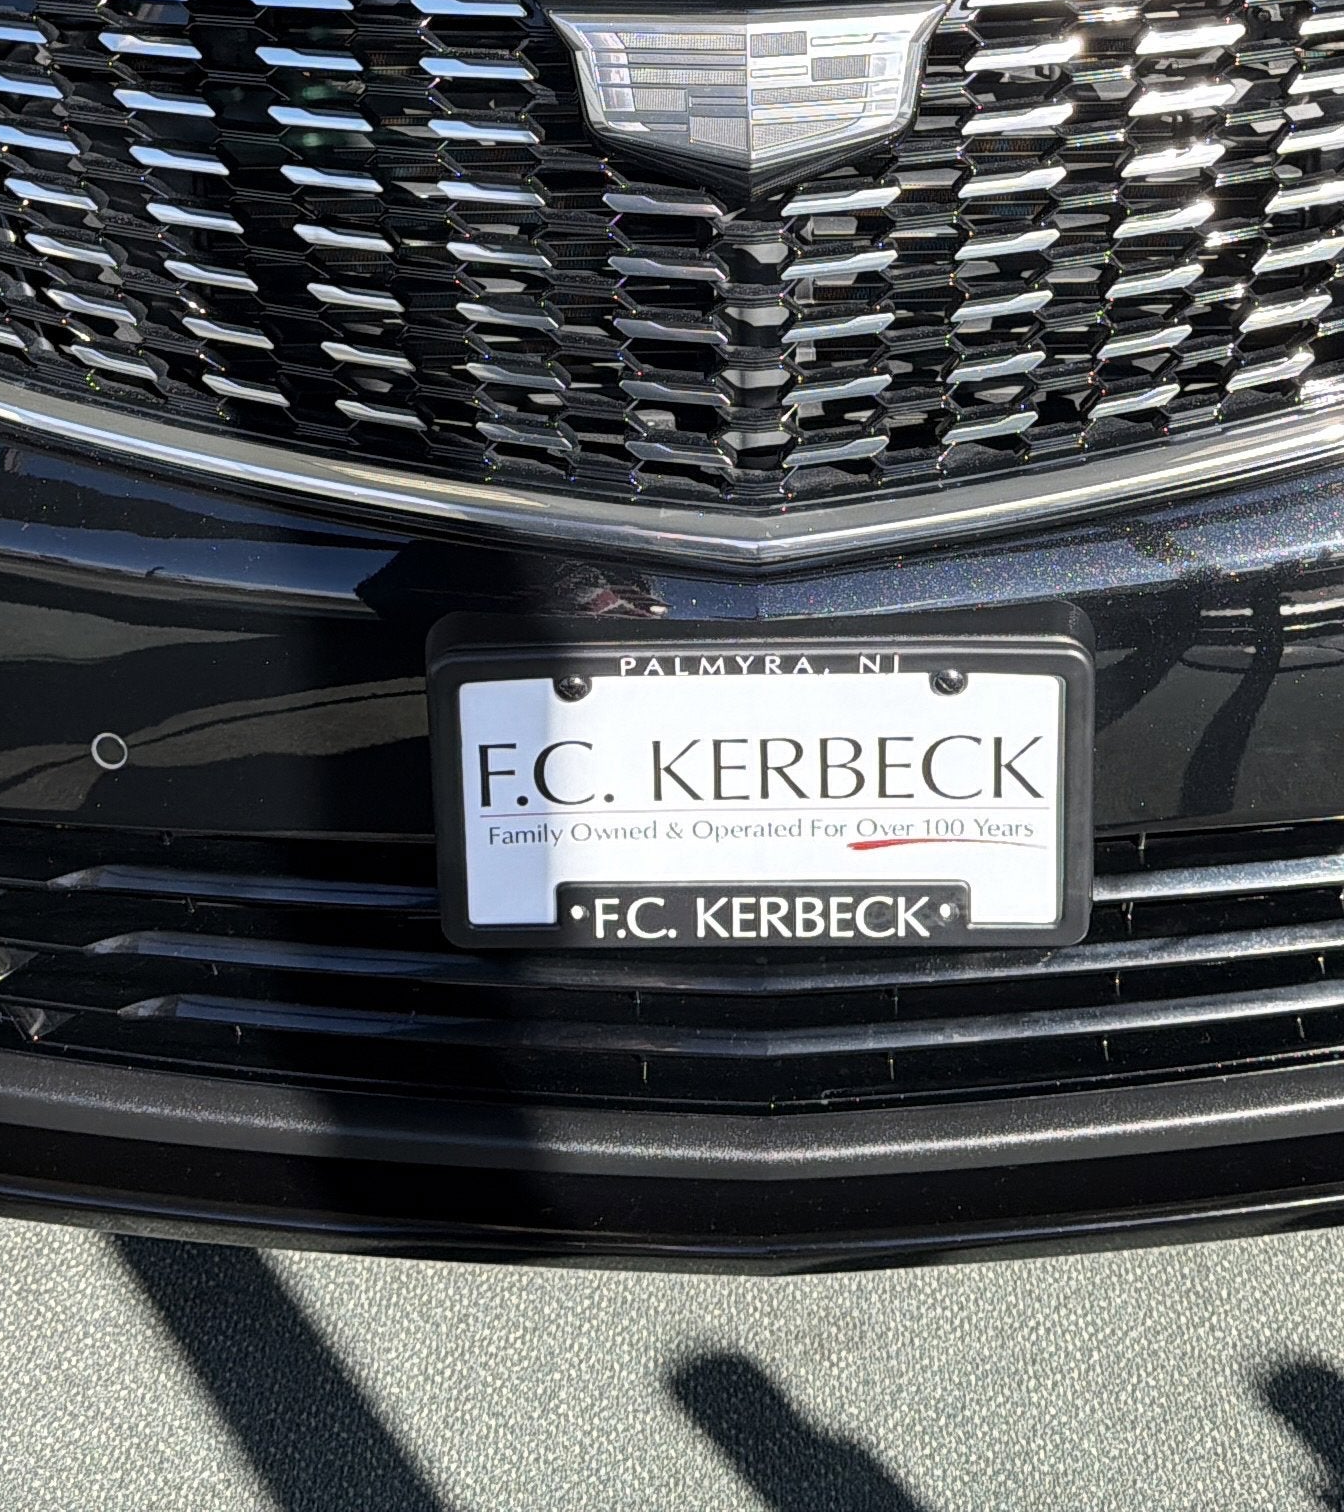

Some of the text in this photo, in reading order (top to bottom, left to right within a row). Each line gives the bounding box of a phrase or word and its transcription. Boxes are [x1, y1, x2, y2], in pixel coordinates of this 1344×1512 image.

[619, 654, 831, 676] PALMYRA,
[479, 734, 1045, 807] F.C. KERBECK
[489, 818, 1035, 847] Family Owned & Operated For Over 100 Years
[594, 895, 931, 939] F.C. KERBECK
